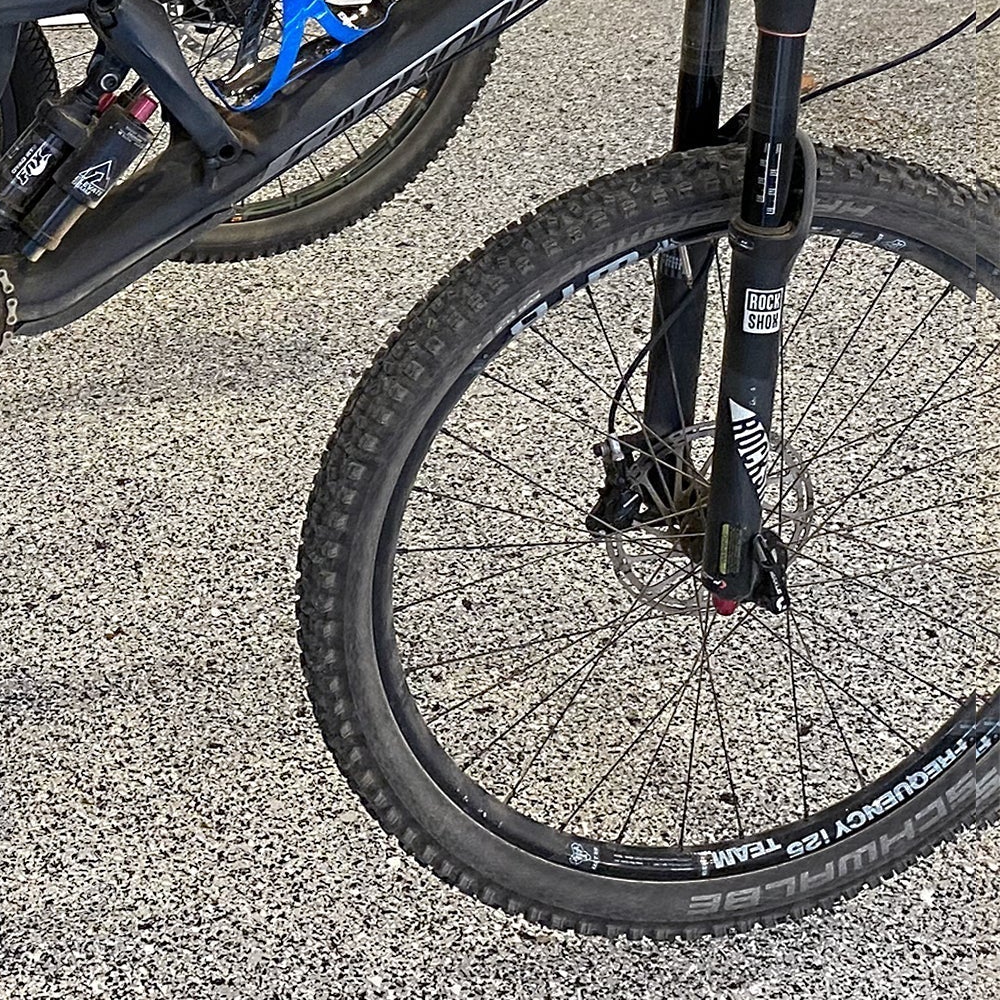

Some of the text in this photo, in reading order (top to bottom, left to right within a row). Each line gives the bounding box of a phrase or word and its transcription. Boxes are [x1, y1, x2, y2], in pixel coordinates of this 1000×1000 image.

[748, 312, 779, 330] SHOX
[749, 293, 781, 310] ROCK
[712, 737, 968, 870] FREQUENCY i25 TEAM
[686, 769, 976, 916] SCHWALBE
